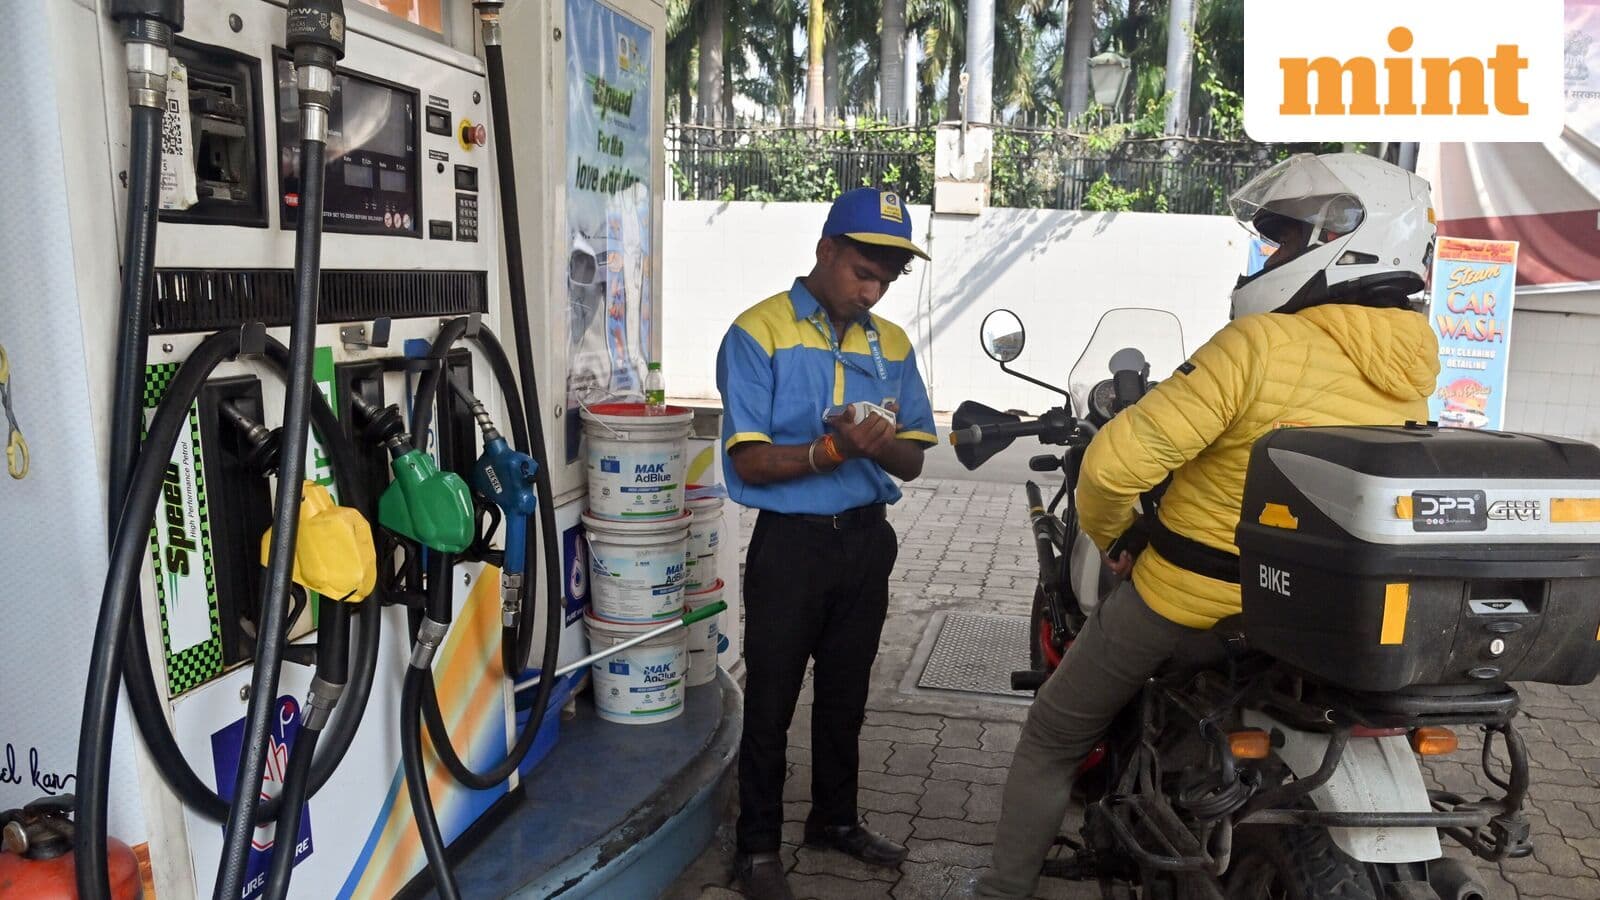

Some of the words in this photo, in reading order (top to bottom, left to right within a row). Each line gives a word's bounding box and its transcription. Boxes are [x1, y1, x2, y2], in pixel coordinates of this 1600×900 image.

[597, 130, 610, 153] For
[611, 135, 624, 157] the
[575, 156, 599, 191] love
[1446, 264, 1501, 290] Steam
[1447, 290, 1496, 316] CAR
[1436, 314, 1504, 343] WASH
[181, 441, 190, 466] Petrol
[486, 467, 501, 491] DIESEL
[634, 463, 665, 474] MAK
[634, 473, 672, 483] AdBlue
[183, 465, 196, 519] Performance
[1421, 497, 1476, 515] DPR
[1487, 500, 1541, 521] GIVI
[1259, 564, 1291, 597] BIKE
[643, 662, 671, 675] MAK
[242, 872, 265, 899] URE
